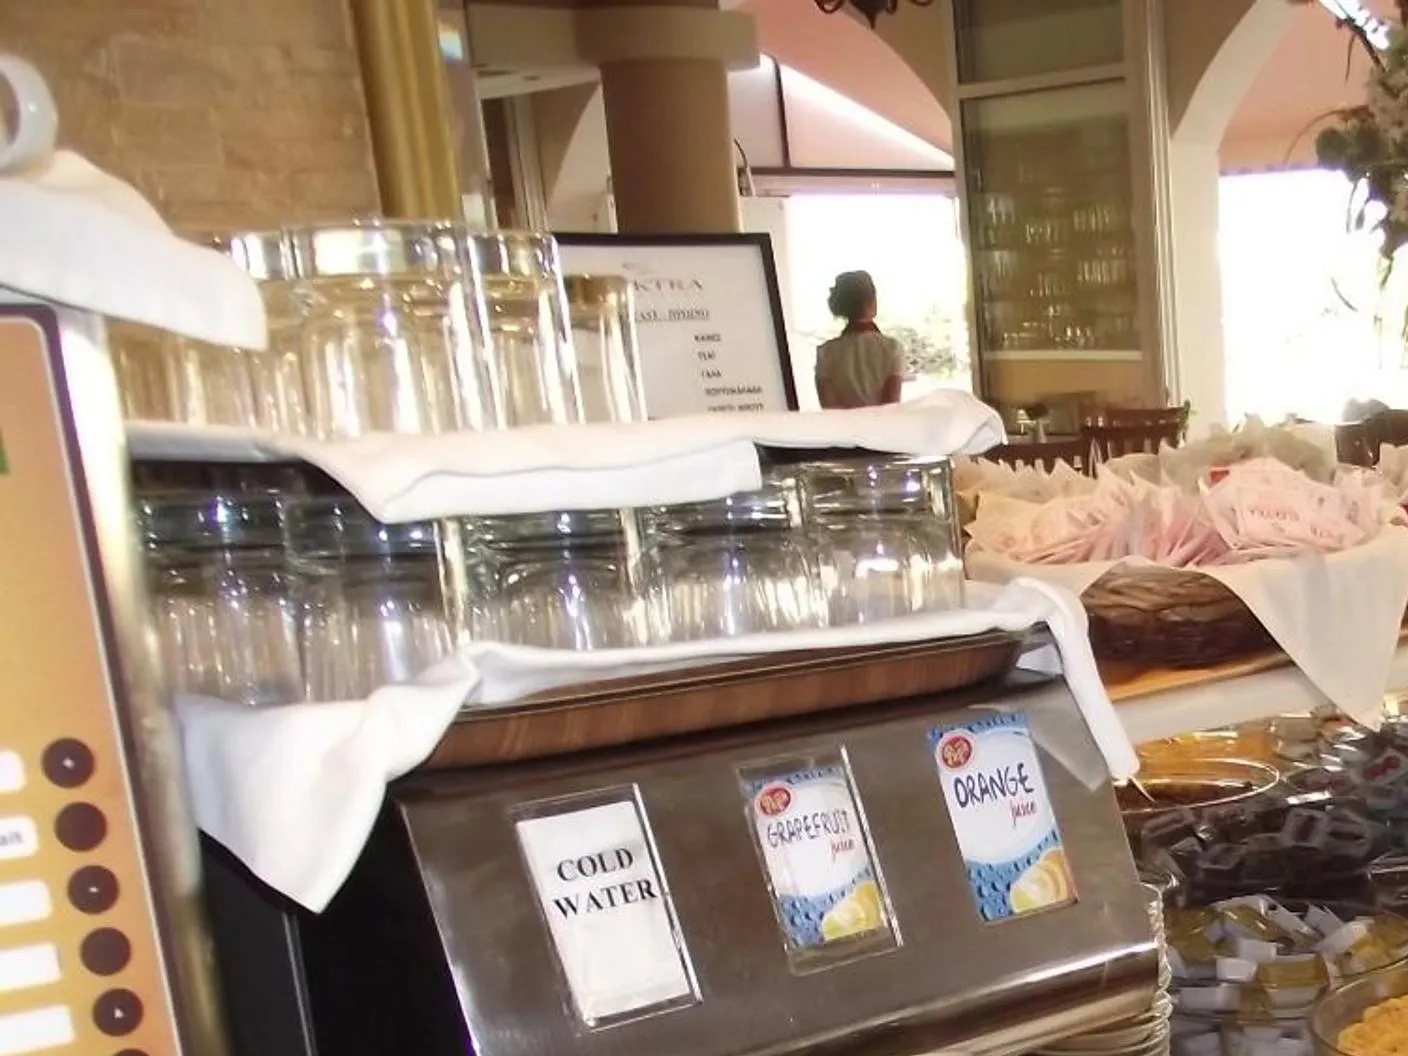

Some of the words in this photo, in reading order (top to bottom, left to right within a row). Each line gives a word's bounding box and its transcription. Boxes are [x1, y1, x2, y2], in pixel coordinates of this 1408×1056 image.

[953, 762, 1035, 809] ORANGE
[766, 808, 850, 849] GRAPEFRUIT
[557, 848, 634, 882] COLD
[552, 879, 658, 920] WATER
